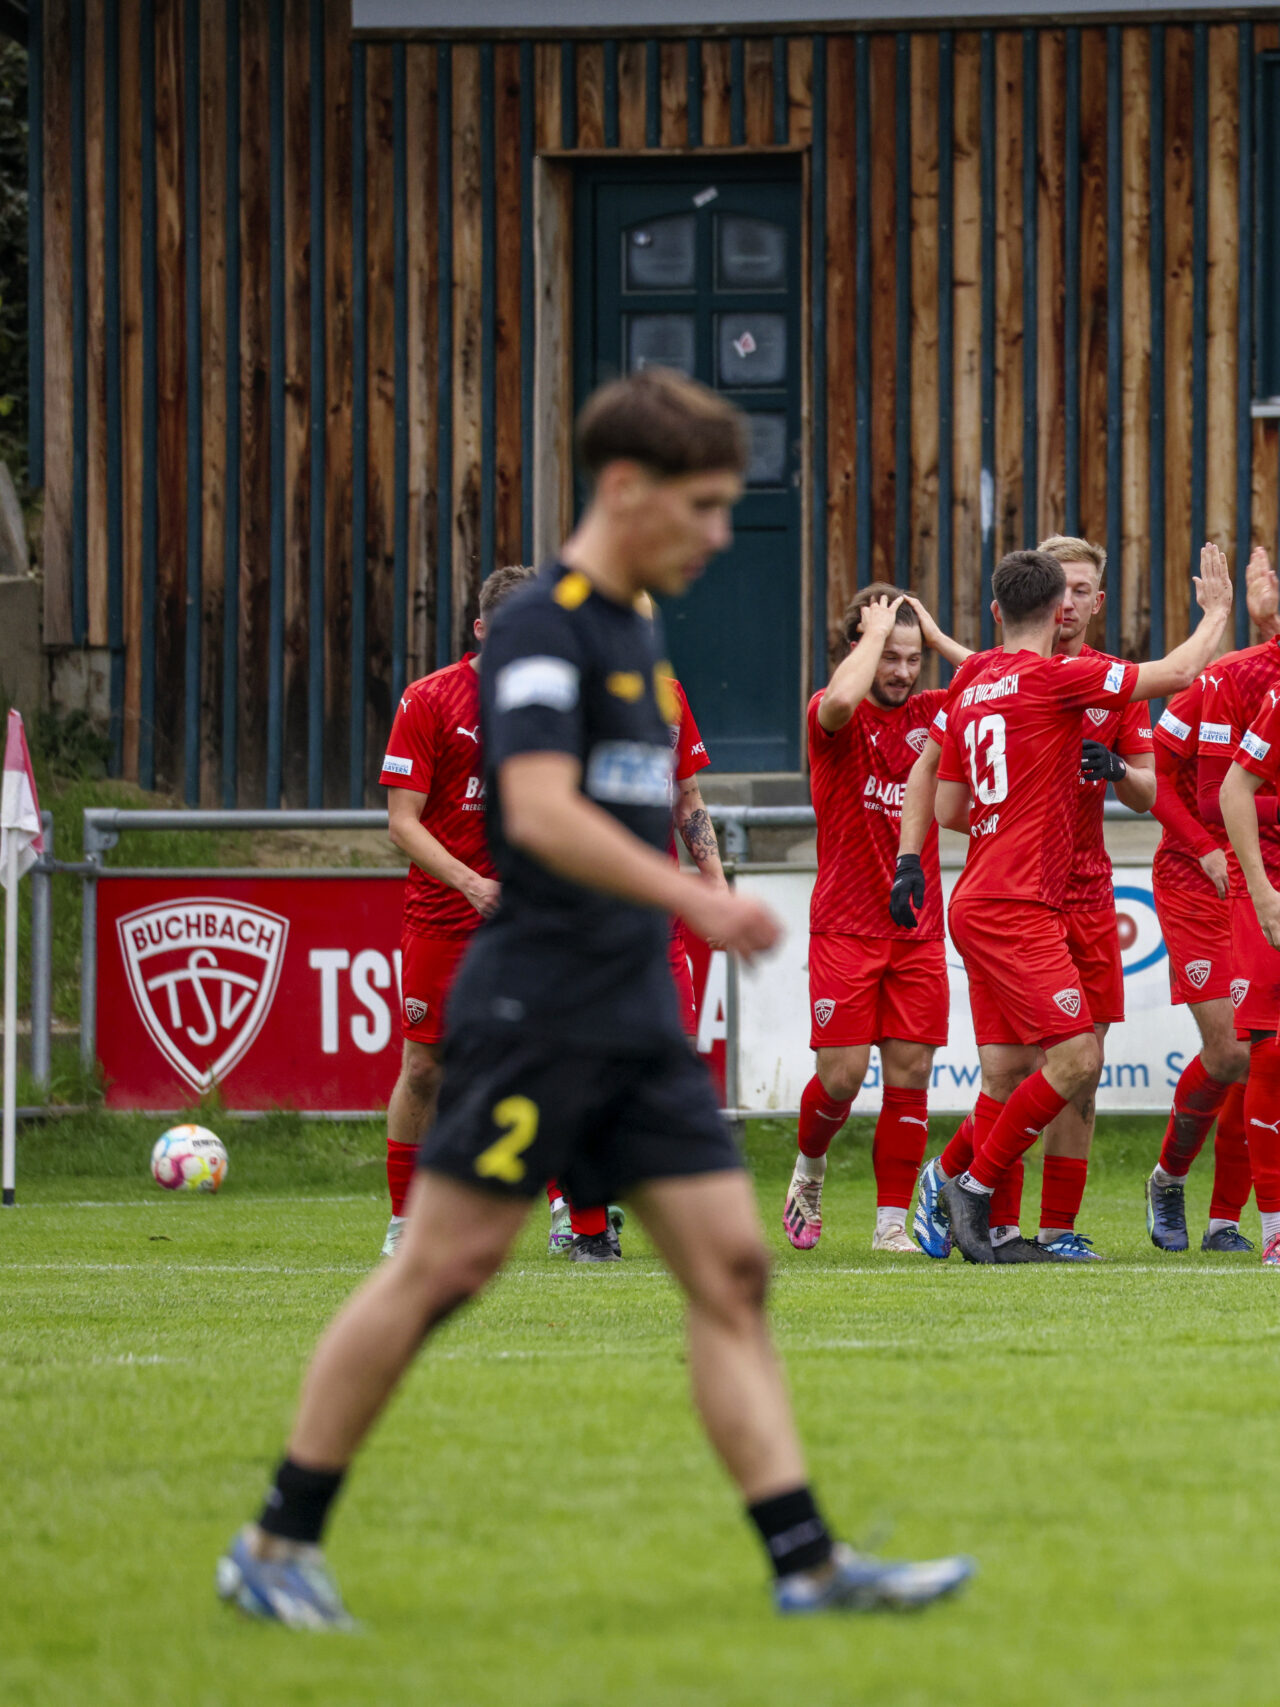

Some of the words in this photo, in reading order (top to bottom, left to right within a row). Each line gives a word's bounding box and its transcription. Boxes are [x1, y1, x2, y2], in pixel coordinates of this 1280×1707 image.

[864, 774, 908, 806] BAUE
[964, 714, 1009, 805] 13
[131, 914, 276, 953] BUCHBACH
[147, 949, 259, 1046] TSV
[476, 1095, 539, 1182] 2
